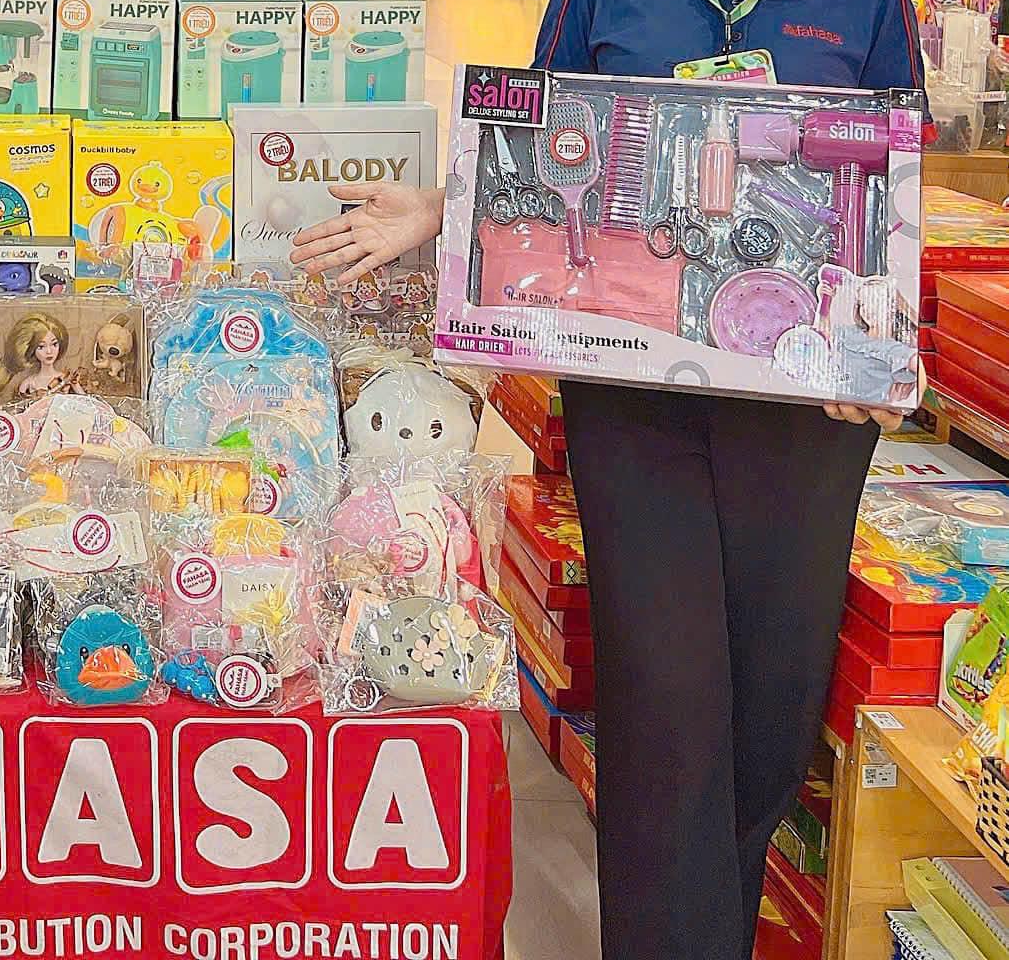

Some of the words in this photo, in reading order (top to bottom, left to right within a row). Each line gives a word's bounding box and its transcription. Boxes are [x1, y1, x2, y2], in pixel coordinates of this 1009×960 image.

[110, 3, 170, 19] HAPPY
[236, 10, 296, 25] HAPPY
[360, 10, 421, 25] HAPPY
[468, 74, 540, 122] salon
[517, 110, 530, 119] SET
[829, 120, 875, 141] salon
[8, 143, 56, 156] cosmos
[80, 146, 113, 154] Duckbill
[114, 146, 137, 155] baby
[277, 156, 410, 183] BALODY
[449, 319, 487, 337] Hair
[454, 338, 477, 350] HAIR
[478, 340, 505, 353] DRIER
[182, 569, 209, 585] FAHASA
[240, 583, 277, 593] DAISY
[233, 667, 244, 696] FAHASA
[164, 921, 459, 960] CORPORATION
